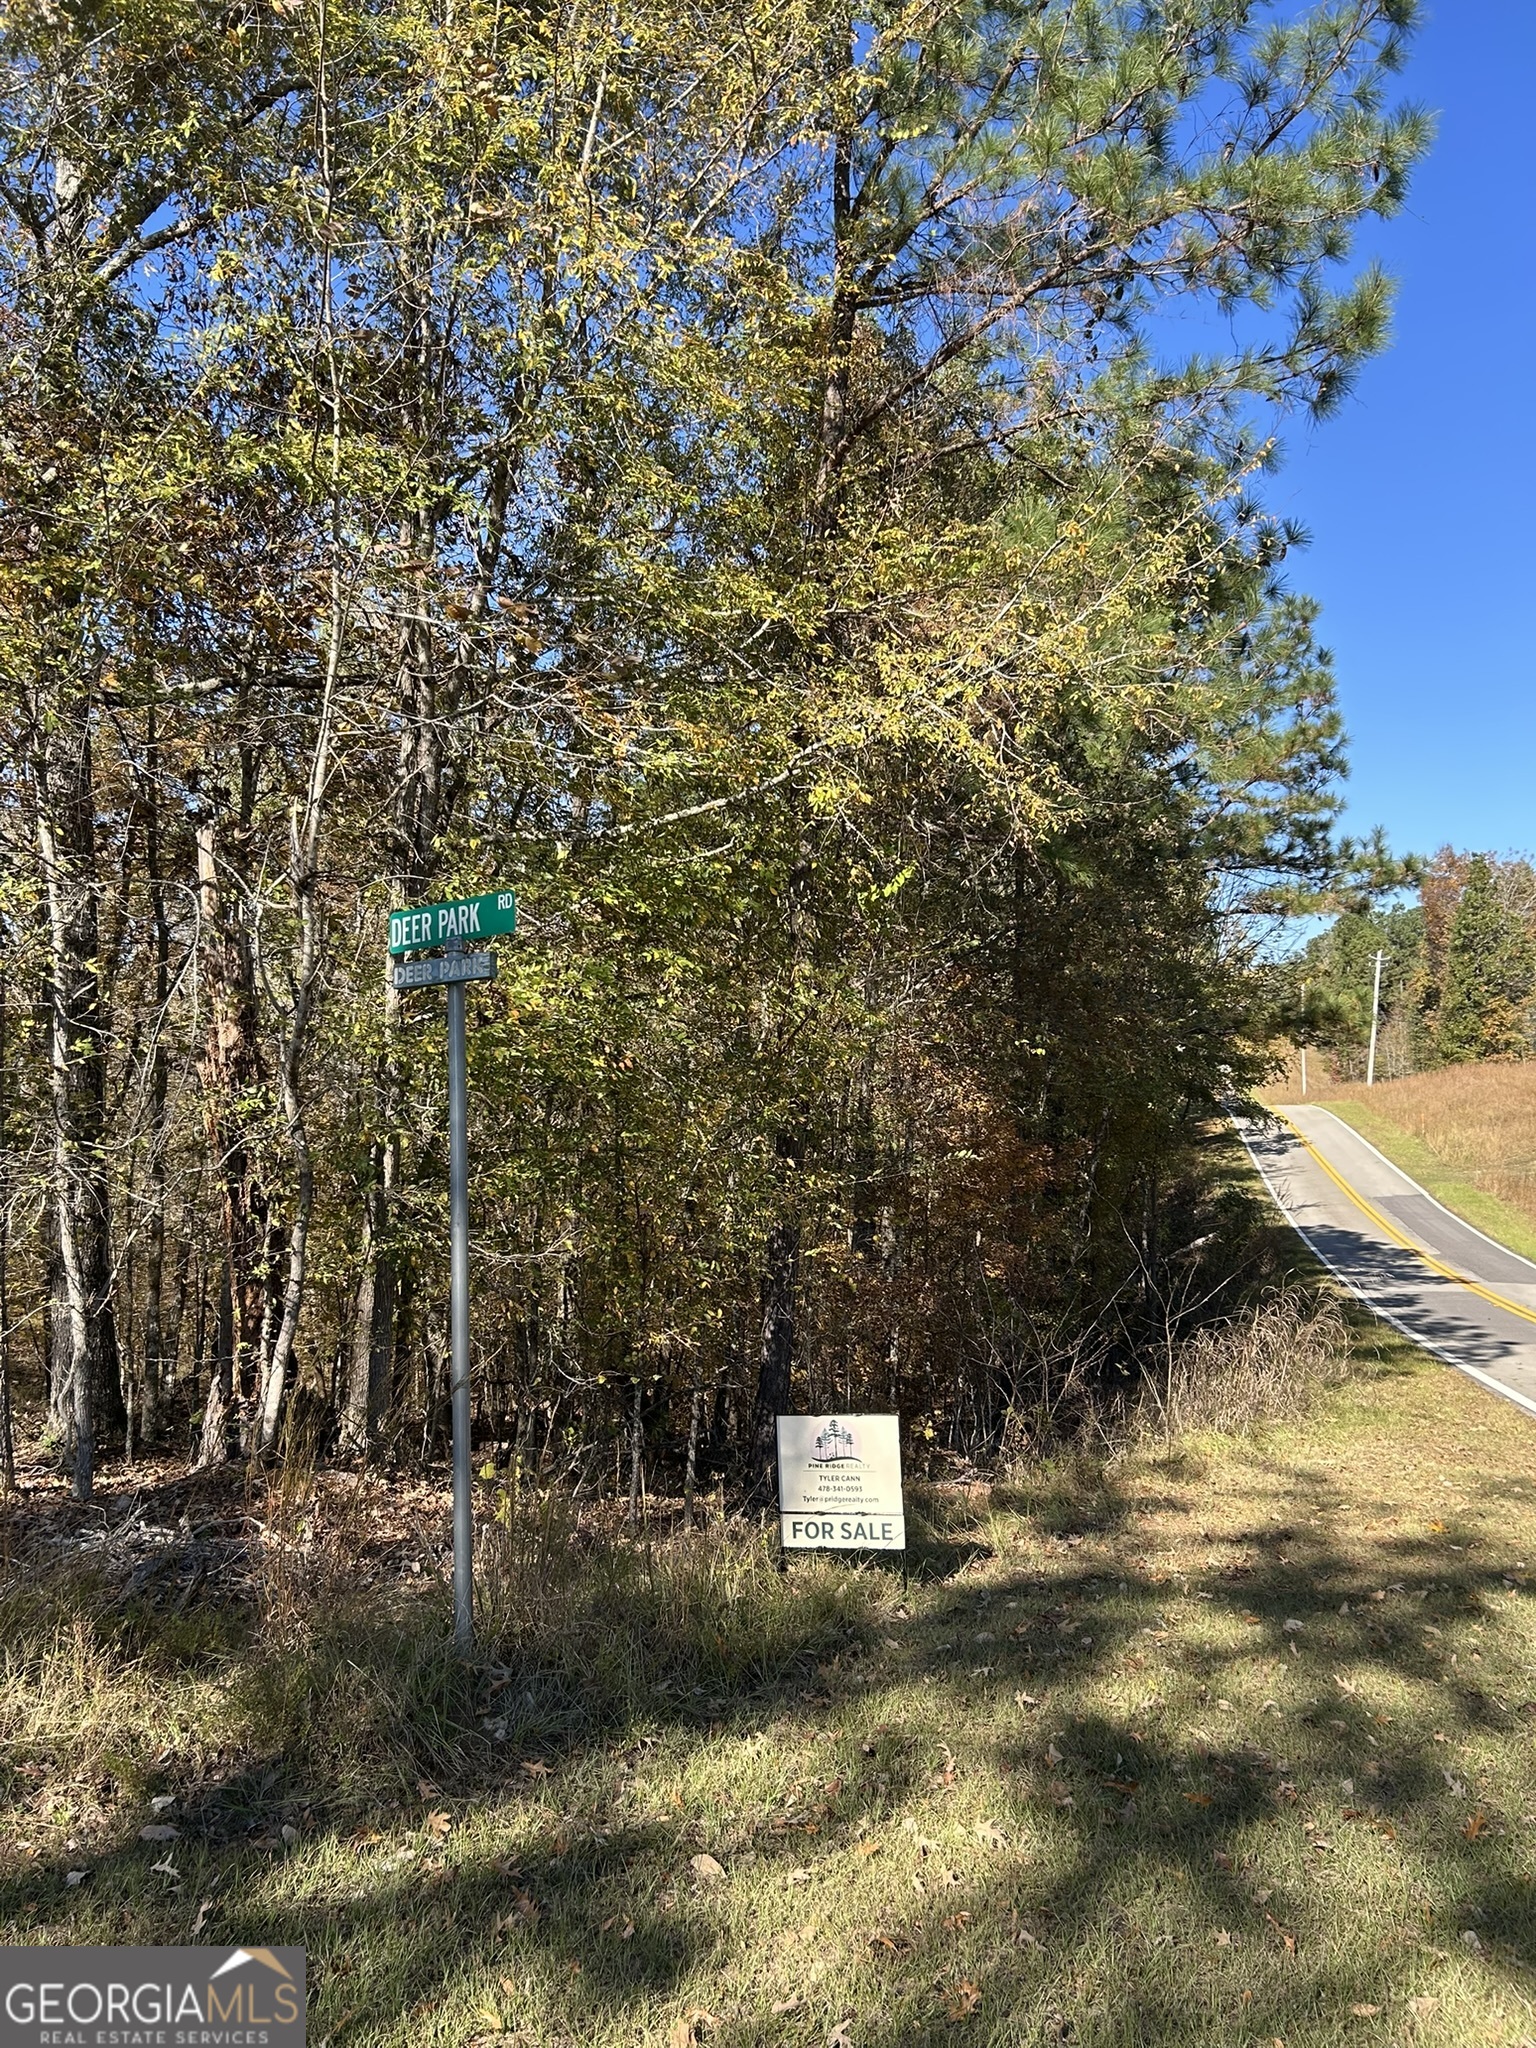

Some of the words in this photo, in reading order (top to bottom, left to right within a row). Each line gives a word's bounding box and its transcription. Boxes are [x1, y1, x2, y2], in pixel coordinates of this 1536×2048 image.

[391, 912, 431, 948] DEER
[438, 902, 481, 939] PARK
[498, 893, 513, 910] RD
[394, 963, 432, 985] DEER
[439, 957, 484, 979] PARK
[802, 1495, 879, 1503] Tyler@pridgerealtycom
[792, 1521, 834, 1540] FOR
[841, 1522, 893, 1540] SALE
